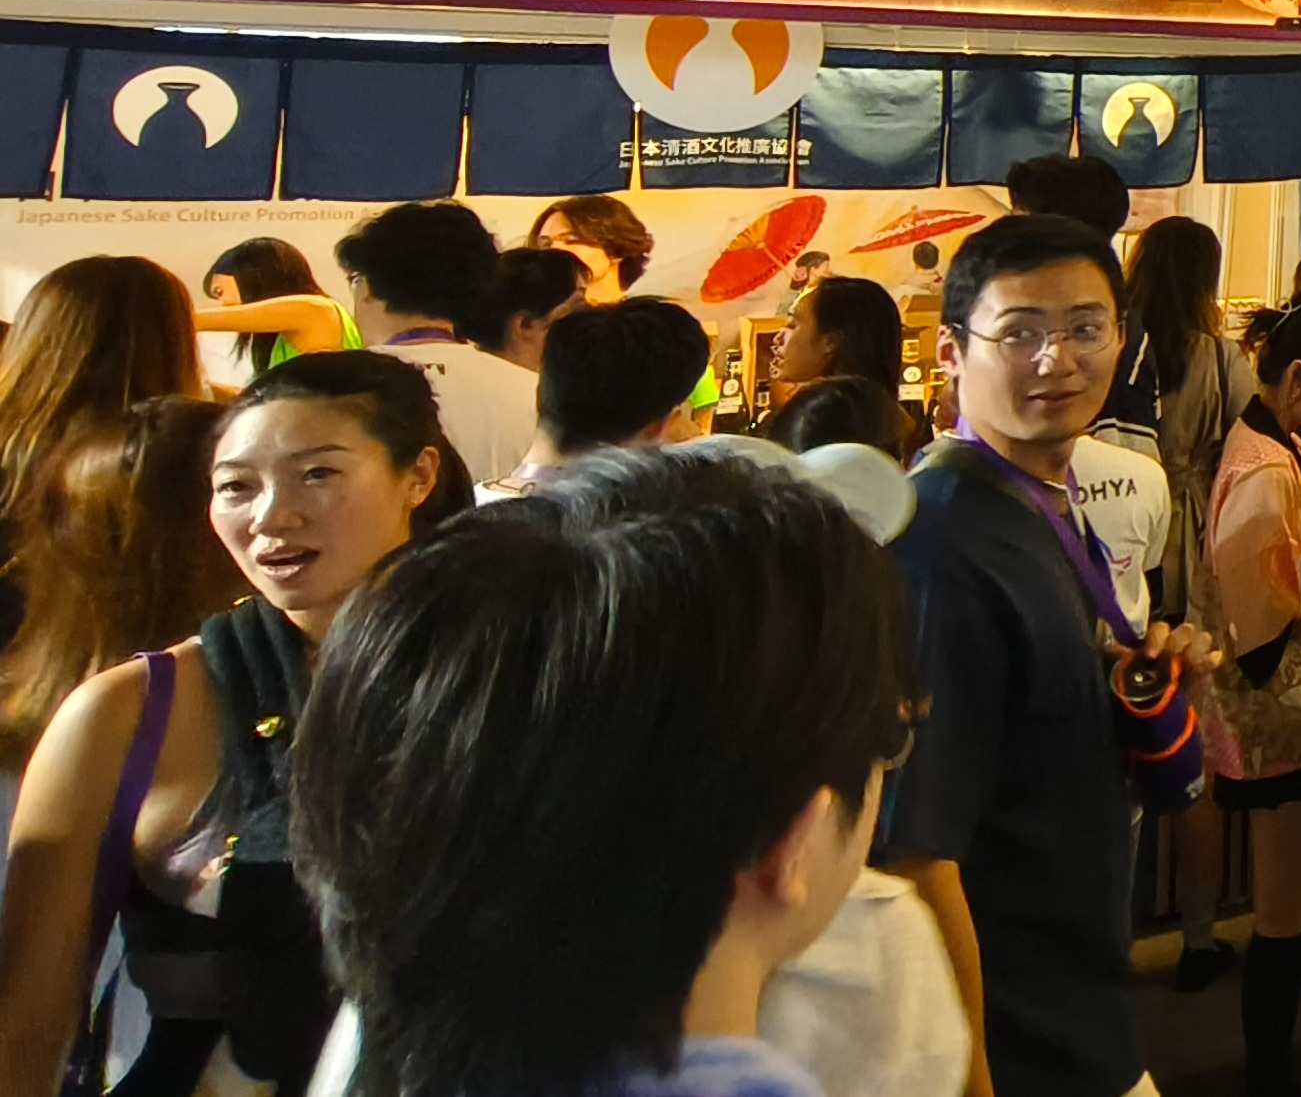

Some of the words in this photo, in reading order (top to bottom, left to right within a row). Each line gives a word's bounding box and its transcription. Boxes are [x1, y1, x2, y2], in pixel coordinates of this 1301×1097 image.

[16, 207, 116, 224] Japanese
[121, 208, 171, 223] Sake
[176, 207, 251, 222] Culture
[256, 206, 355, 222] Promotion
